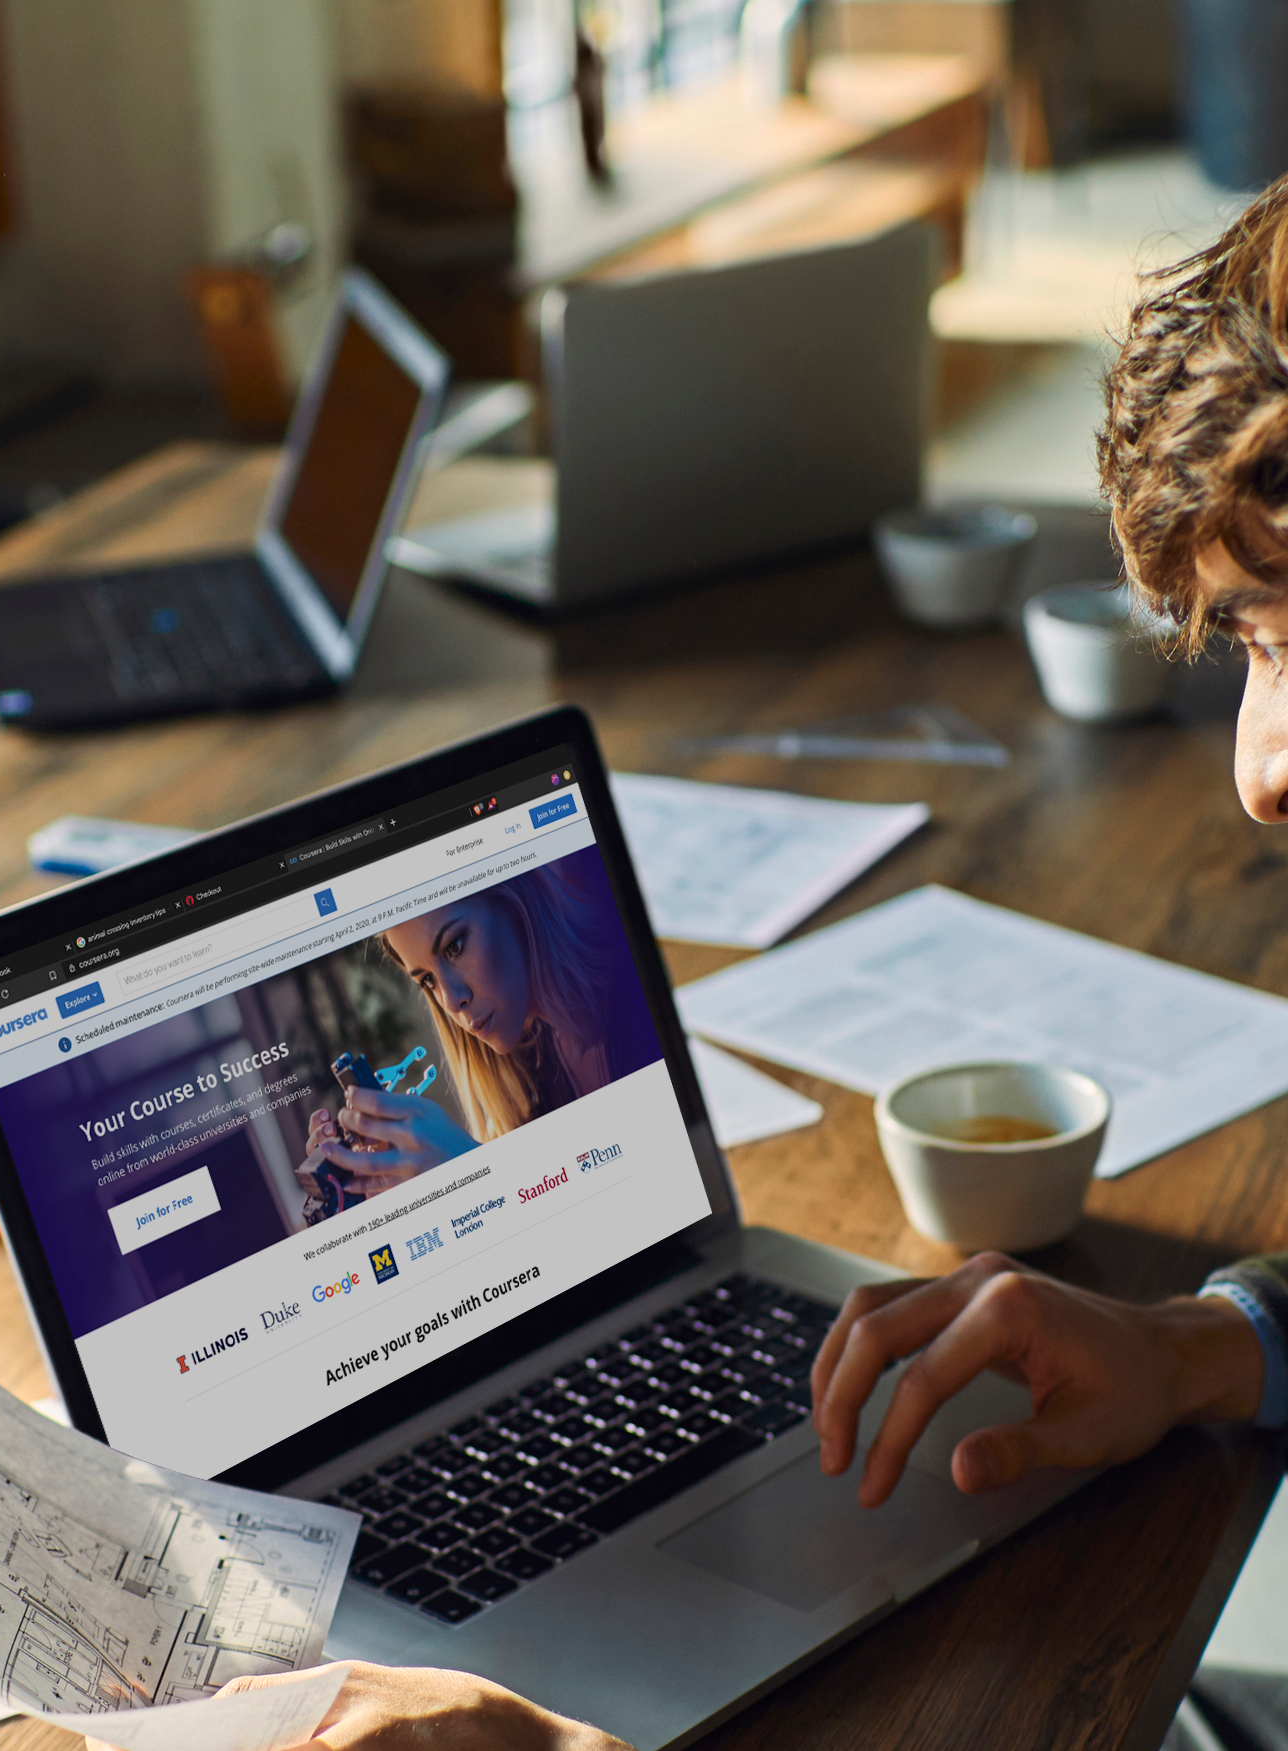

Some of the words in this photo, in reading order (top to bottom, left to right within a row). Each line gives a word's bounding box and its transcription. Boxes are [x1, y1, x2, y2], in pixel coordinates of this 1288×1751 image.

[537, 812, 548, 822] Join
[557, 803, 570, 812] Free
[456, 838, 483, 853] Enterprise
[504, 825, 516, 834] Log
[299, 848, 323, 861] Coursera
[325, 841, 338, 851] Build
[338, 837, 352, 846] Skills
[196, 886, 222, 900] Checkout
[88, 930, 106, 942] animal
[155, 908, 166, 916] tips
[75, 1021, 115, 1044] Scheduled
[115, 1003, 165, 1028] maintenance:
[166, 991, 194, 1007] Coursera
[195, 985, 205, 996] will
[213, 969, 248, 990] performing
[248, 958, 274, 974] site-wide
[275, 943, 312, 963] maintenance
[312, 934, 335, 948] starting
[333, 927, 348, 939] April
[355, 919, 371, 930] 2020,
[381, 909, 394, 919] P.M.
[396, 902, 413, 913] Pacific
[413, 897, 427, 906] Time
[428, 890, 438, 901] and
[439, 887, 448, 896] will
[457, 872, 486, 889] unavailable
[521, 852, 537, 863] hours.
[79, 948, 120, 968] coursera.org
[123, 972, 143, 985] What
[143, 969, 153, 978] do
[154, 964, 167, 976] you
[167, 956, 184, 968] want
[192, 943, 212, 958] learn?
[65, 995, 90, 1009] Explore
[79, 1111, 125, 1141] Your
[130, 1083, 194, 1120] Course
[197, 1074, 217, 1092] to
[220, 1042, 289, 1082] Success
[91, 1151, 115, 1170] Build
[116, 1143, 139, 1159] skills
[139, 1134, 159, 1149] with
[160, 1119, 196, 1139] courses,
[198, 1097, 246, 1123] certificates,
[247, 1087, 262, 1102] and
[265, 1074, 298, 1095] degrees
[98, 1168, 126, 1186] online
[127, 1158, 149, 1173] from
[150, 1136, 199, 1163] world-class
[199, 1114, 248, 1141] universities
[249, 1104, 265, 1120] and
[266, 1085, 311, 1113] companies
[590, 1144, 622, 1166] Penn
[518, 1167, 568, 1204] Stanford
[136, 1213, 155, 1230] Join
[156, 1205, 170, 1217] for
[172, 1196, 193, 1210] Free
[303, 1251, 315, 1260] We
[316, 1233, 352, 1255] collaborate
[352, 1225, 367, 1237] with
[384, 1206, 409, 1224] leading
[409, 1189, 445, 1212] universities
[444, 1180, 458, 1195] and
[458, 1166, 491, 1188] companies
[451, 1206, 480, 1228] Imperial
[480, 1196, 506, 1213] College
[406, 1227, 444, 1261] IBM
[454, 1220, 483, 1239] London
[372, 1249, 392, 1272] M
[312, 1271, 360, 1302] Google
[260, 1302, 300, 1330] Duke
[326, 1350, 379, 1386] Achieve
[380, 1332, 411, 1361] your
[415, 1312, 449, 1343] goals
[451, 1295, 481, 1319] with
[483, 1266, 540, 1302] Coursera
[191, 1328, 248, 1365] ILLINOIS
